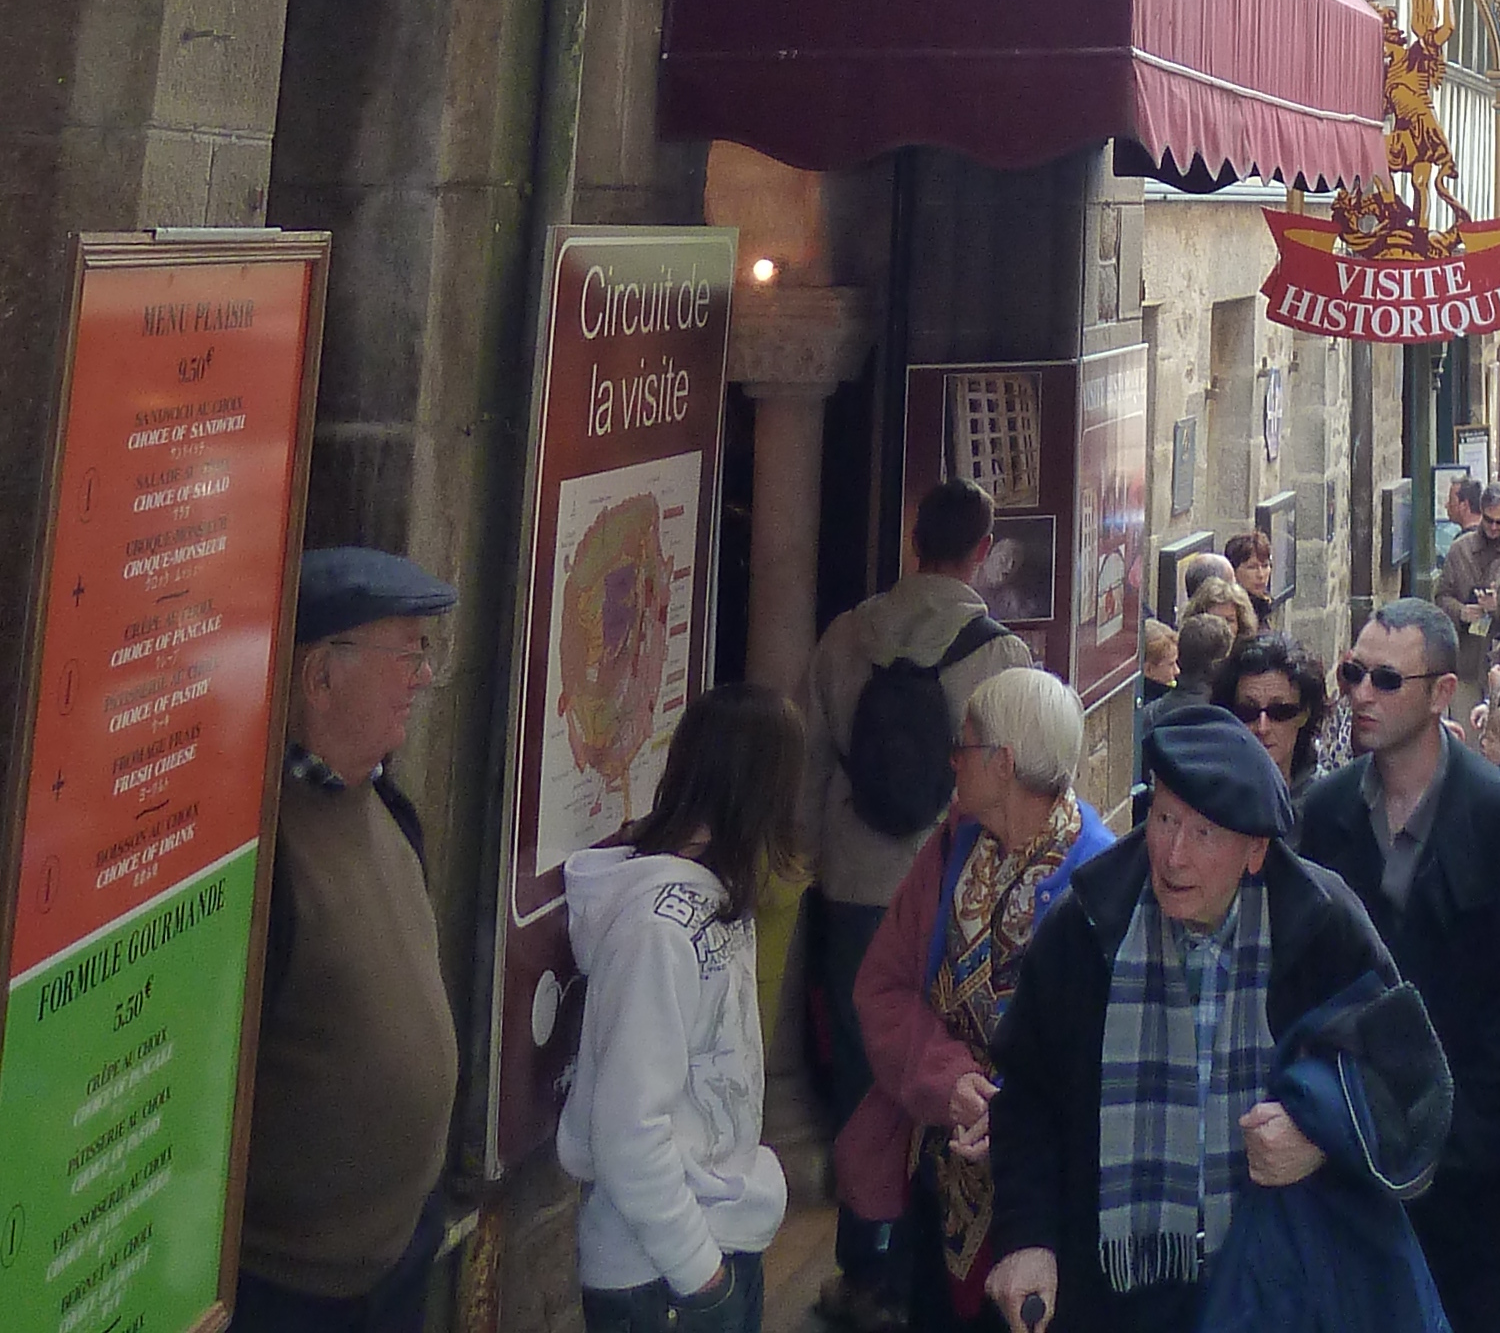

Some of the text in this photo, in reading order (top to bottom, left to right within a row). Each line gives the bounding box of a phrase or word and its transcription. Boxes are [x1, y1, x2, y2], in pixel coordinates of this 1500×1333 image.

[581, 262, 711, 340] Circuit de
[1335, 259, 1471, 301] VISITE
[142, 299, 255, 337] MENU PLAISIR
[588, 355, 689, 437] la visite
[128, 414, 246, 450] CHOICE OF SANDWICH
[134, 476, 230, 513] CHOICE OF SALAD
[111, 638, 154, 668] CHOICE
[155, 631, 172, 652] OF
[172, 614, 223, 646] PANCAKE
[109, 700, 151, 733] CHOICE
[154, 693, 171, 715] OF
[171, 678, 212, 707] PASTRY
[112, 763, 153, 796] FRESH
[154, 743, 198, 777] CHEESE
[96, 852, 141, 889] CHOICE
[141, 842, 160, 864] OF
[159, 822, 196, 856] DRINK
[37, 877, 226, 1022] FORMULE GOURMANDE
[113, 974, 155, 1032] 5.50€
